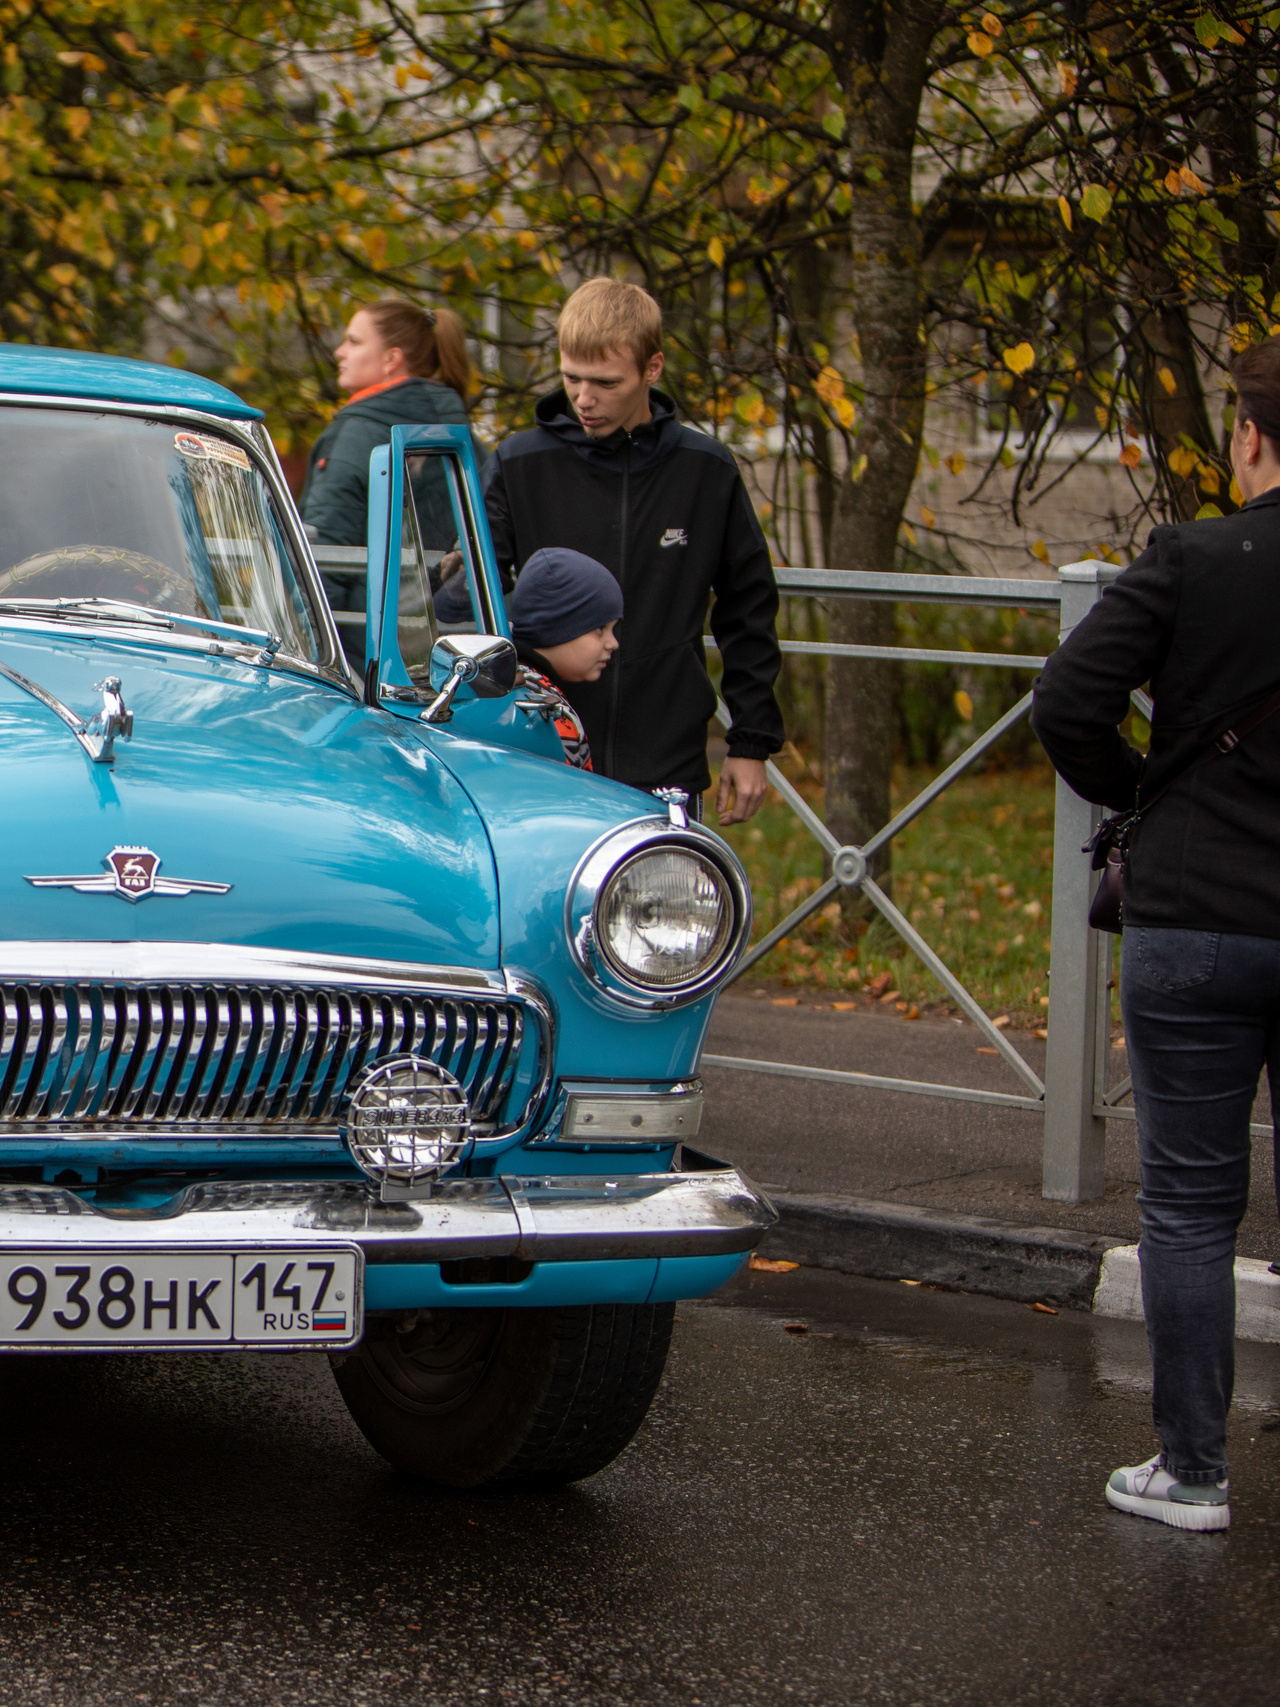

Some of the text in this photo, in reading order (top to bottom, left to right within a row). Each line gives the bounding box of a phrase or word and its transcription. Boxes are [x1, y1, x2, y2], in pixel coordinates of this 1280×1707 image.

[665, 528, 685, 539] NIKE
[240, 1261, 336, 1312] 147
[263, 1312, 310, 1331] RUS
